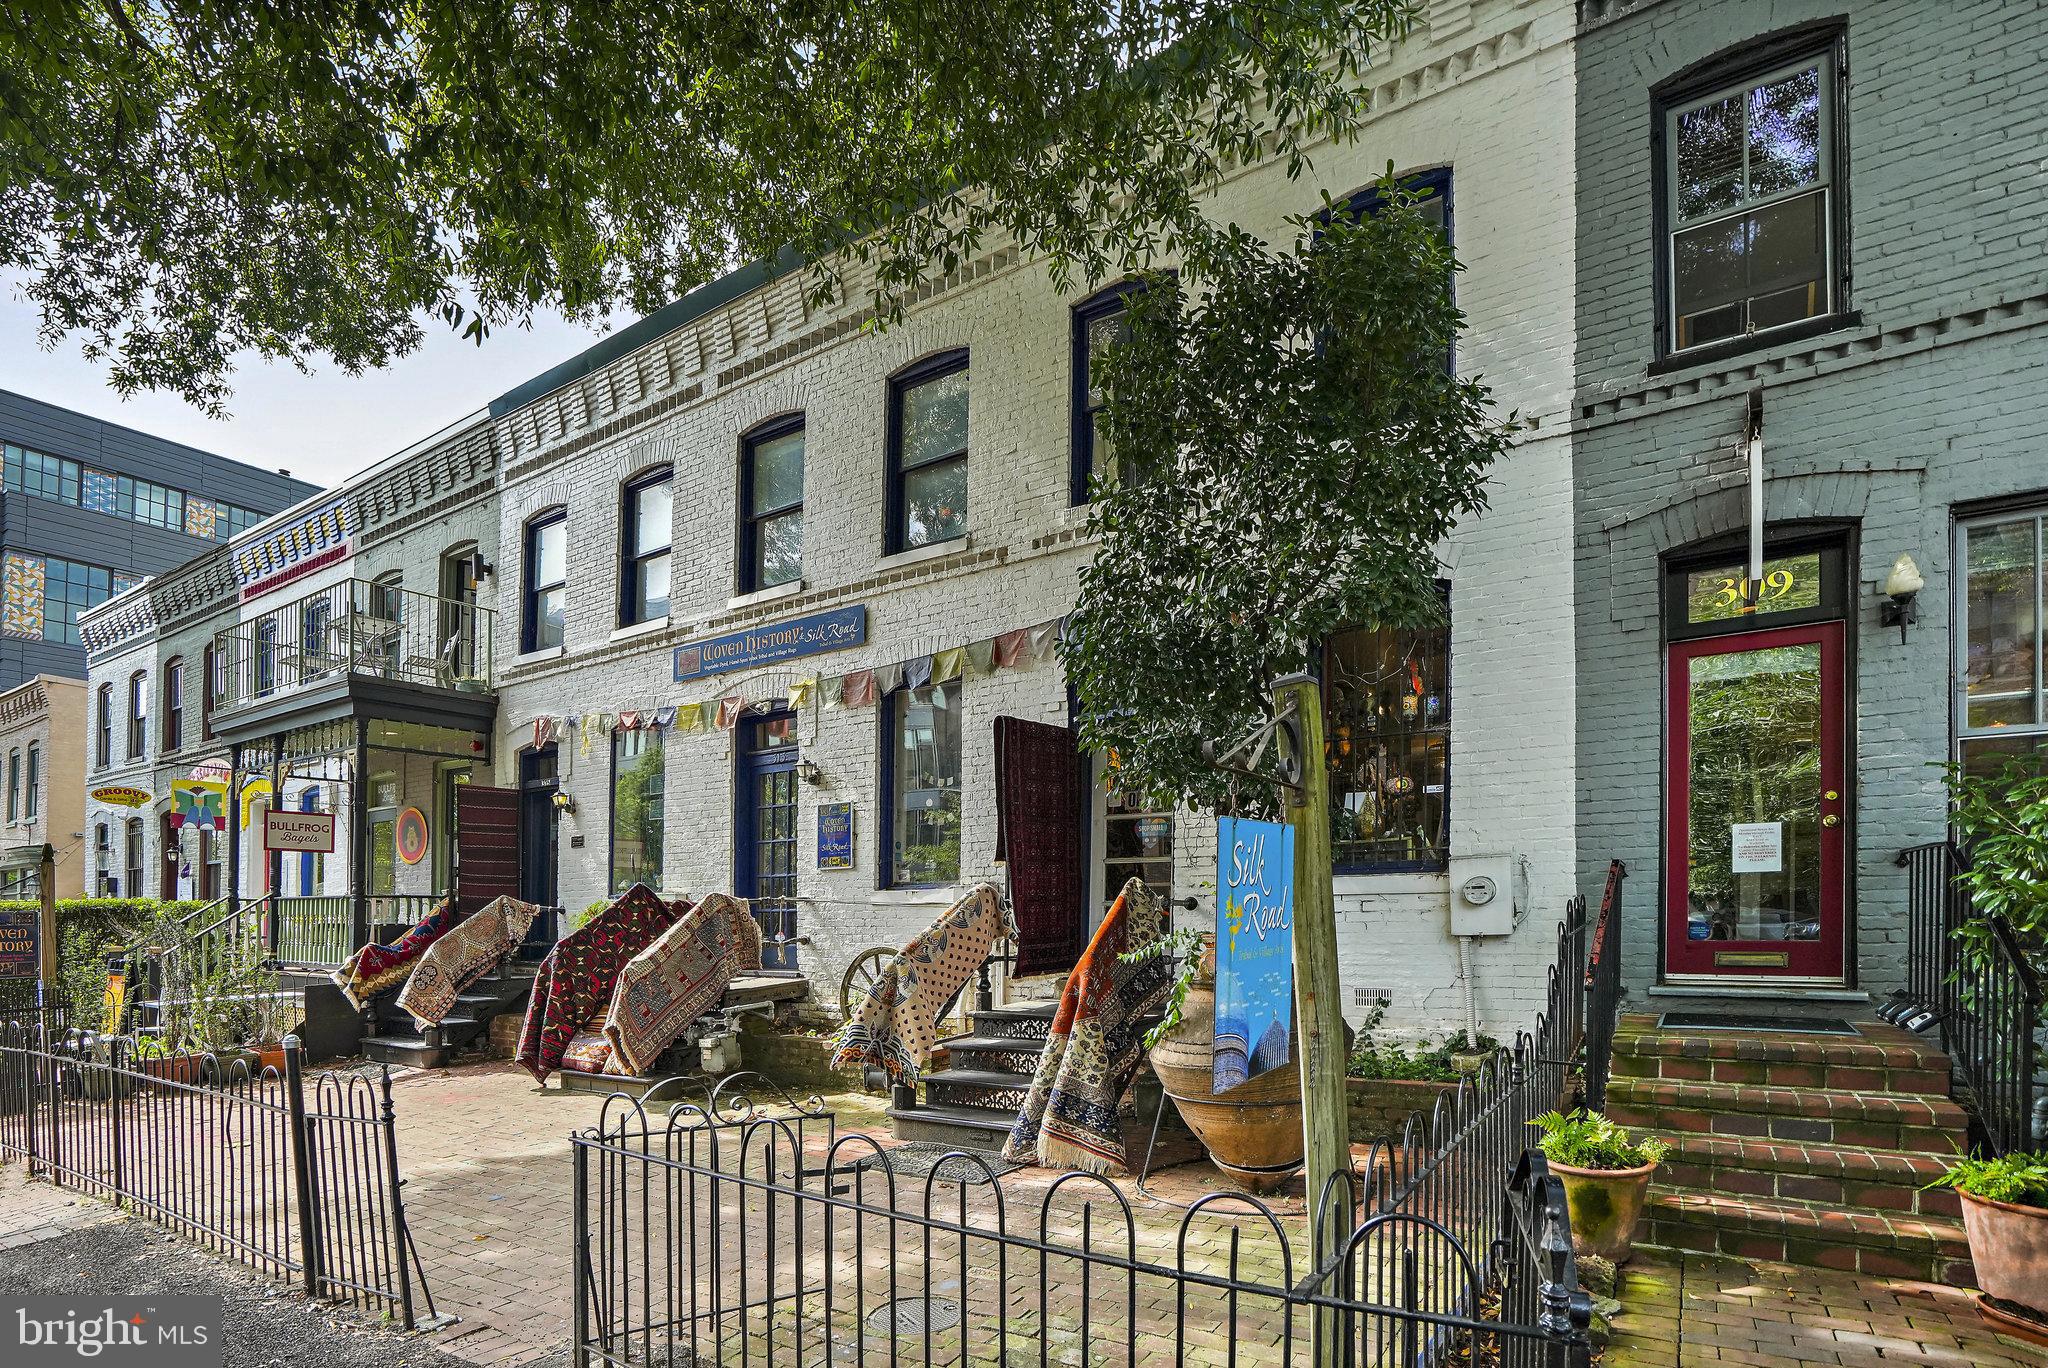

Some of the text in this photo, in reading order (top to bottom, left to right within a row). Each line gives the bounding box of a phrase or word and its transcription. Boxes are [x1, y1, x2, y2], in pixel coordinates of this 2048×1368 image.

[1715, 570, 1794, 608] 309
[804, 624, 829, 643] Silk
[828, 617, 860, 638] Road
[94, 788, 148, 800] GROOVY
[270, 821, 330, 833] BULLFROG
[280, 831, 320, 845] Bagels
[1227, 834, 1272, 896] Silk
[1243, 886, 1290, 941] Road
